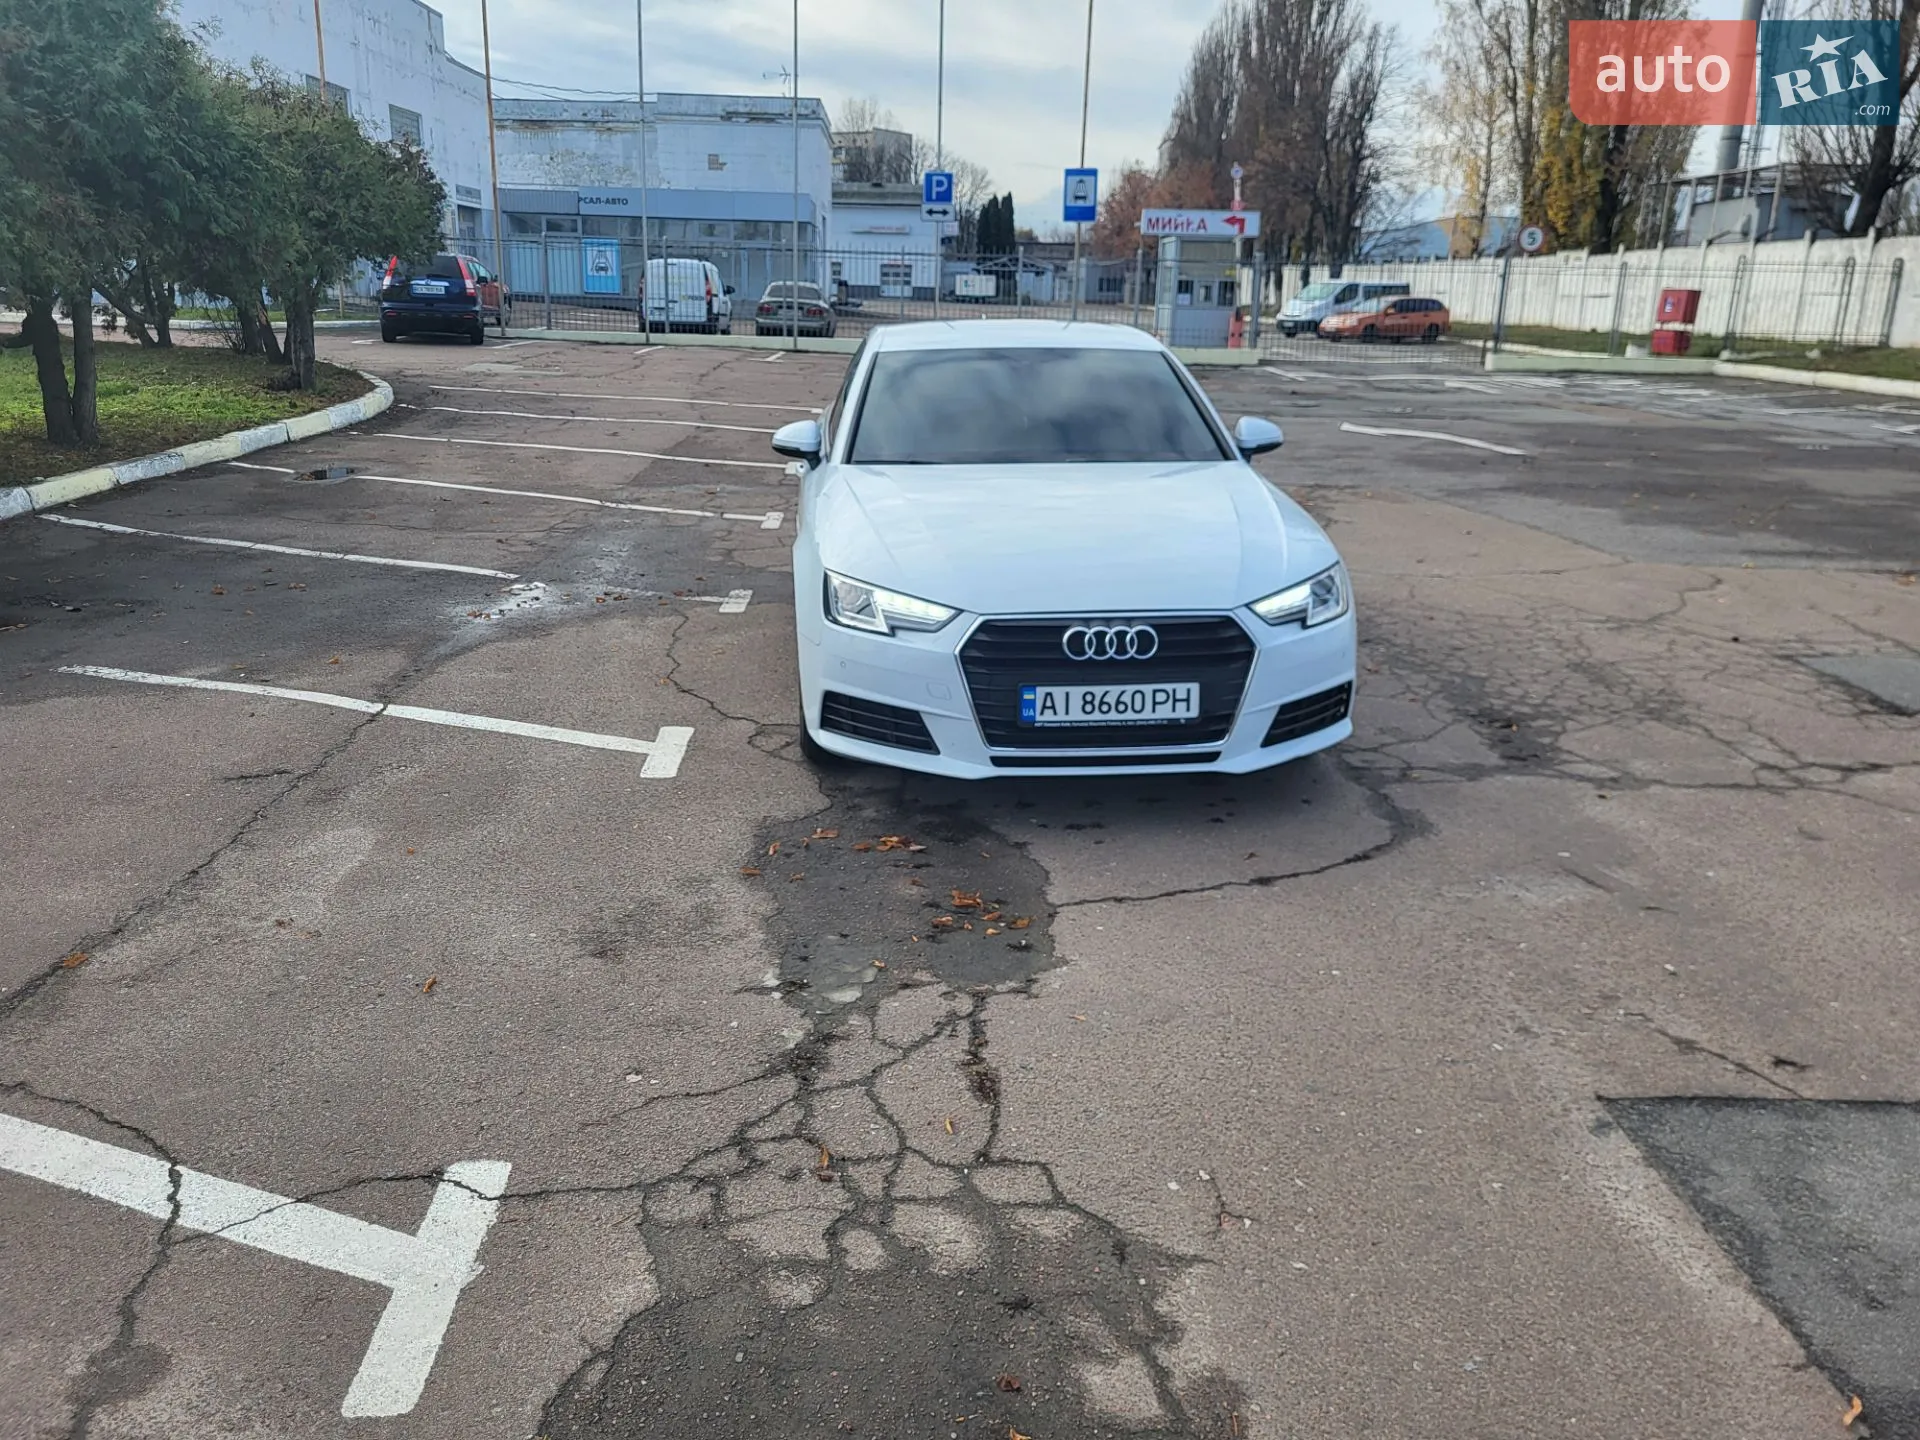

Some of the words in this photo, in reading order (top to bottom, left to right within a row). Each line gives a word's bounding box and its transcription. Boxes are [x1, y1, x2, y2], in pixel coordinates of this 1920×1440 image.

[931, 175, 949, 200] P
[1527, 231, 1537, 246] 5
[1022, 708, 1035, 717] UA
